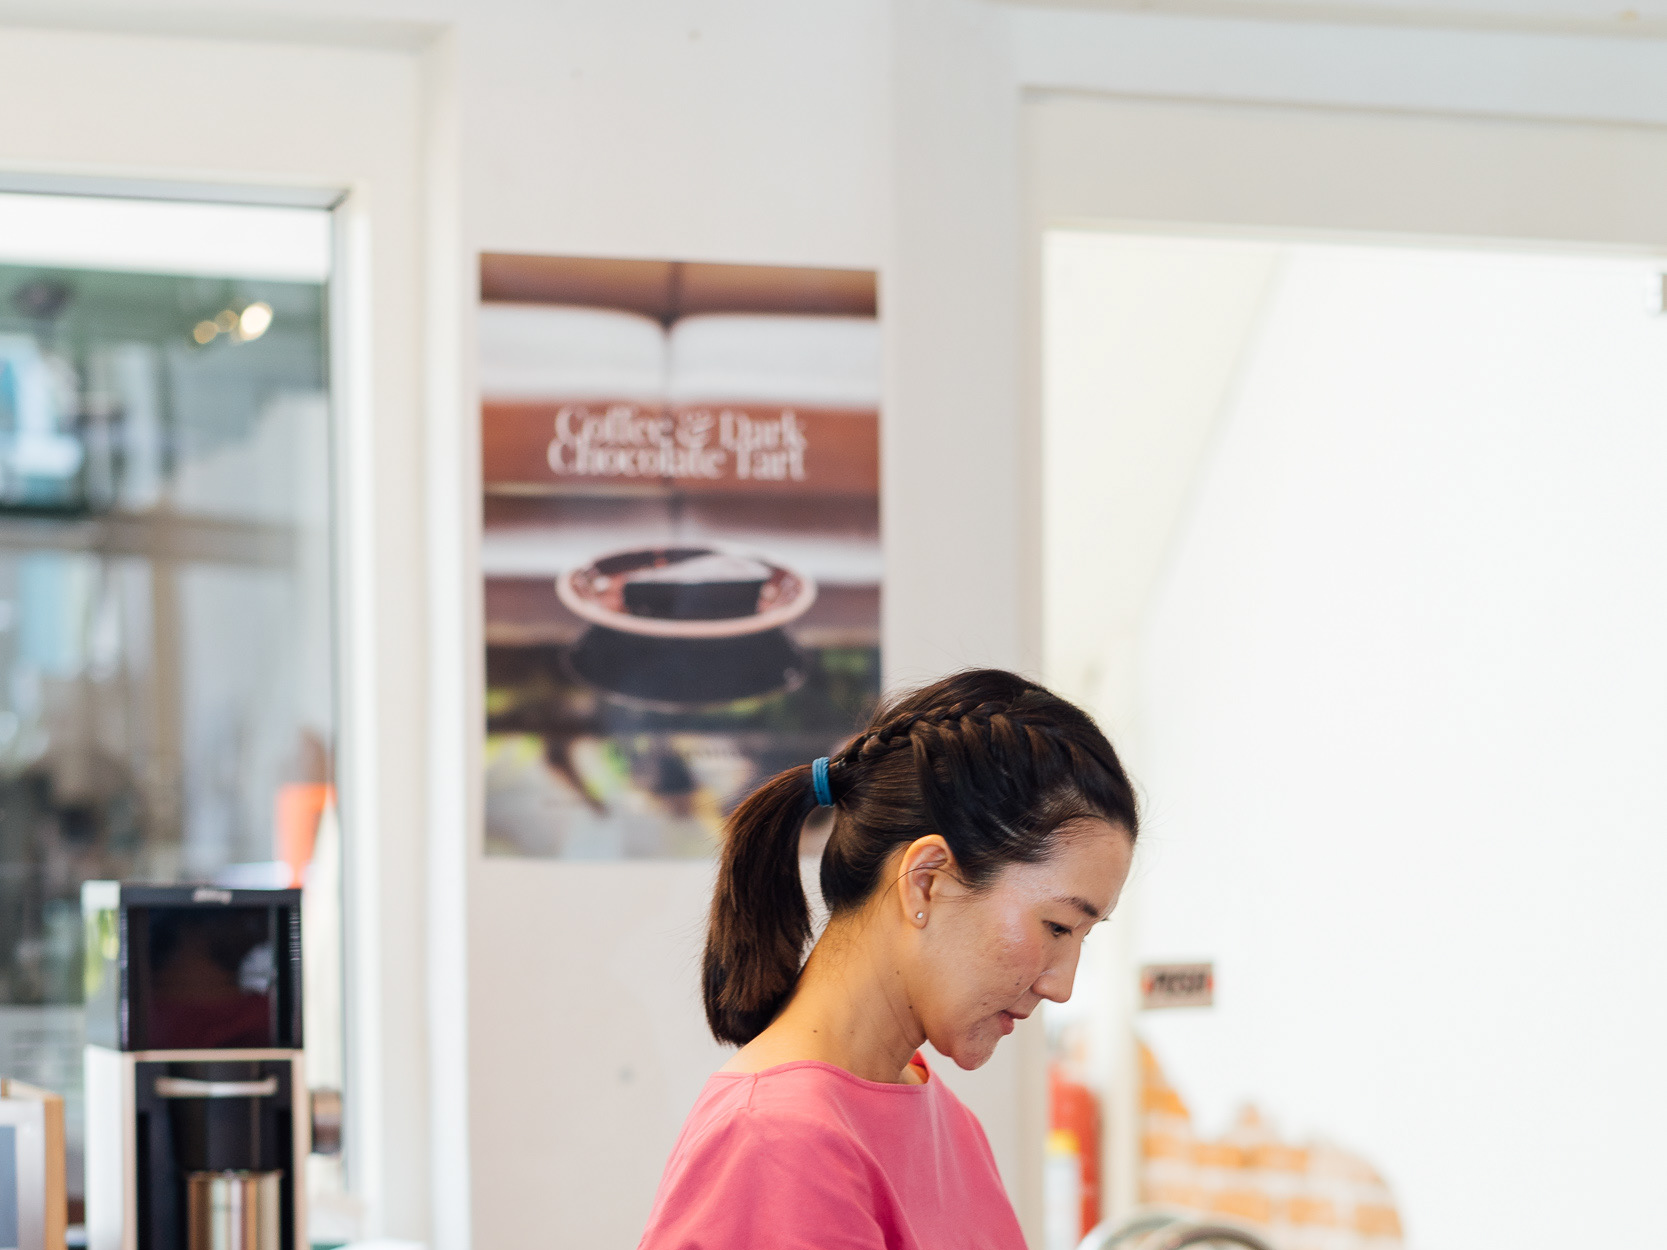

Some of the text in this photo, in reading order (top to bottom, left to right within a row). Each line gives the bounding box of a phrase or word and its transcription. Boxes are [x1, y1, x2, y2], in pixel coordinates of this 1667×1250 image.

[555, 405, 808, 452] Coffee & Dark
[547, 438, 806, 481] Chocolate Tart
